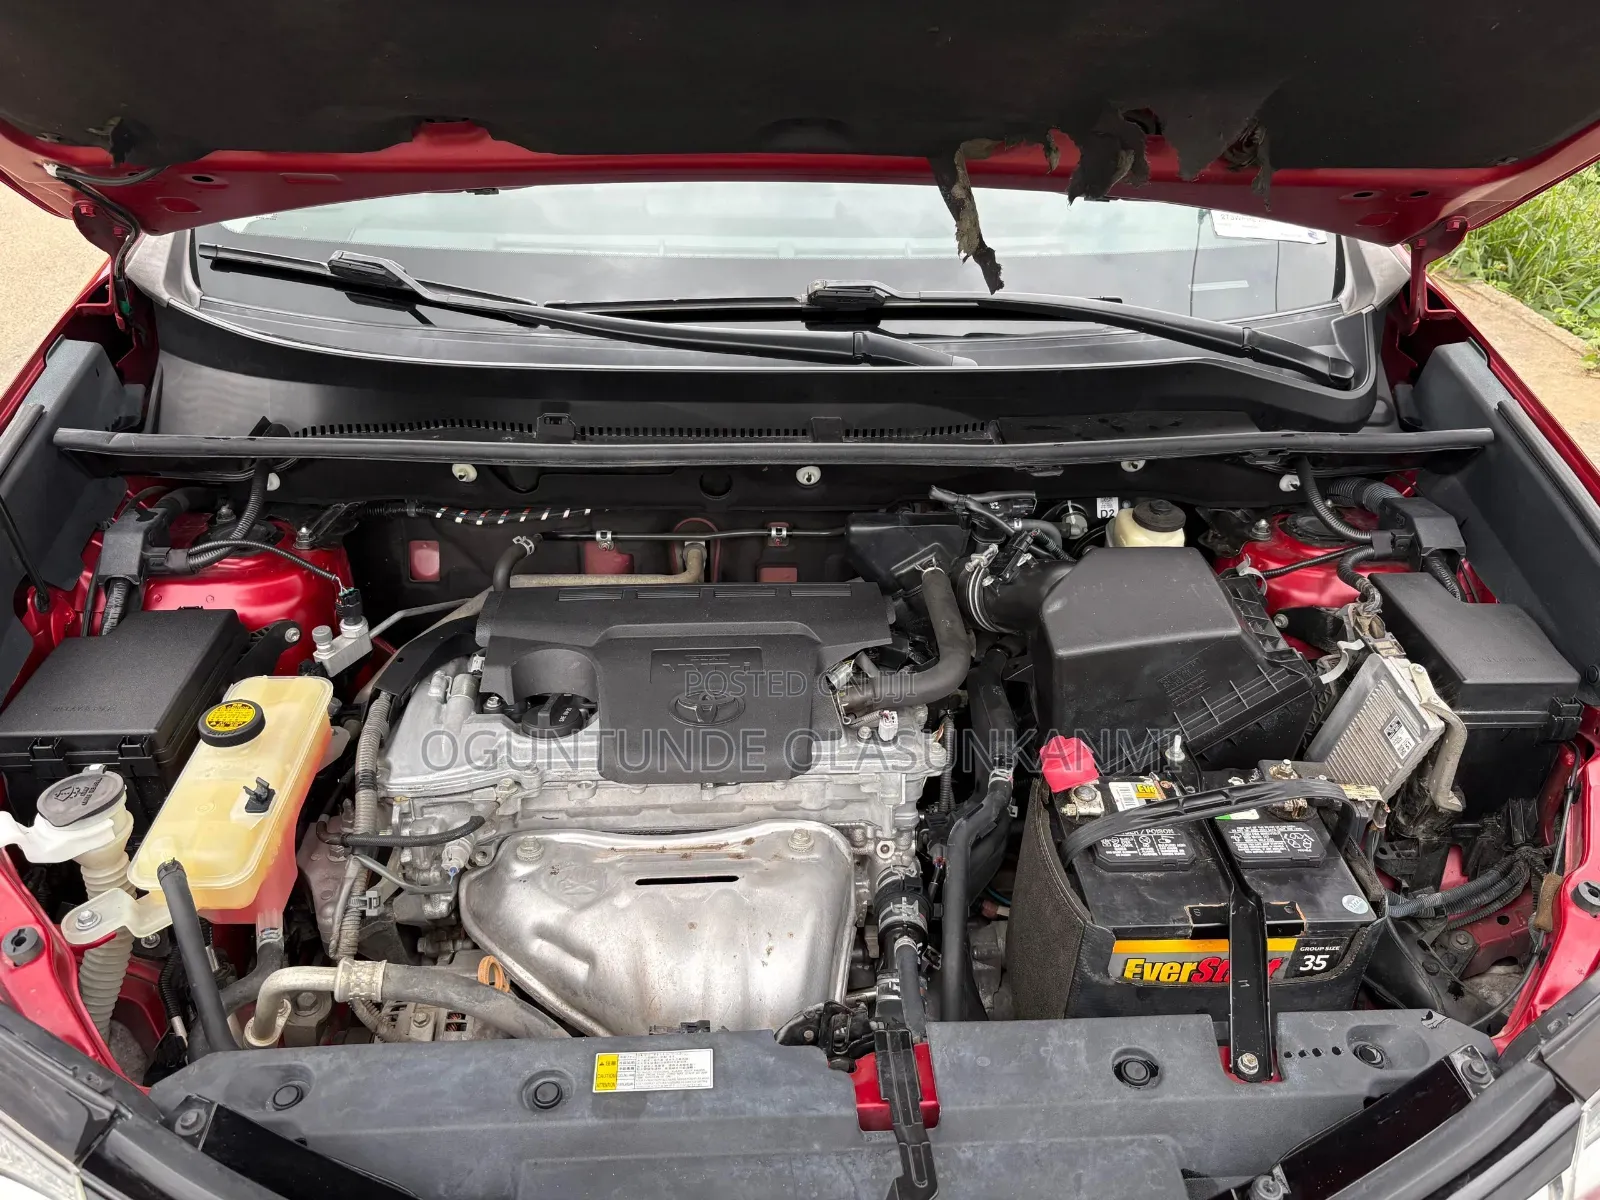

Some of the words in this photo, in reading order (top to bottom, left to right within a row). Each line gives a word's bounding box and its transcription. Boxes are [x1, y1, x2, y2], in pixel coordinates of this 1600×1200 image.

[1100, 509, 1115, 518] D2
[1122, 956, 1284, 983] EverStt
[1299, 954, 1331, 971] 35
